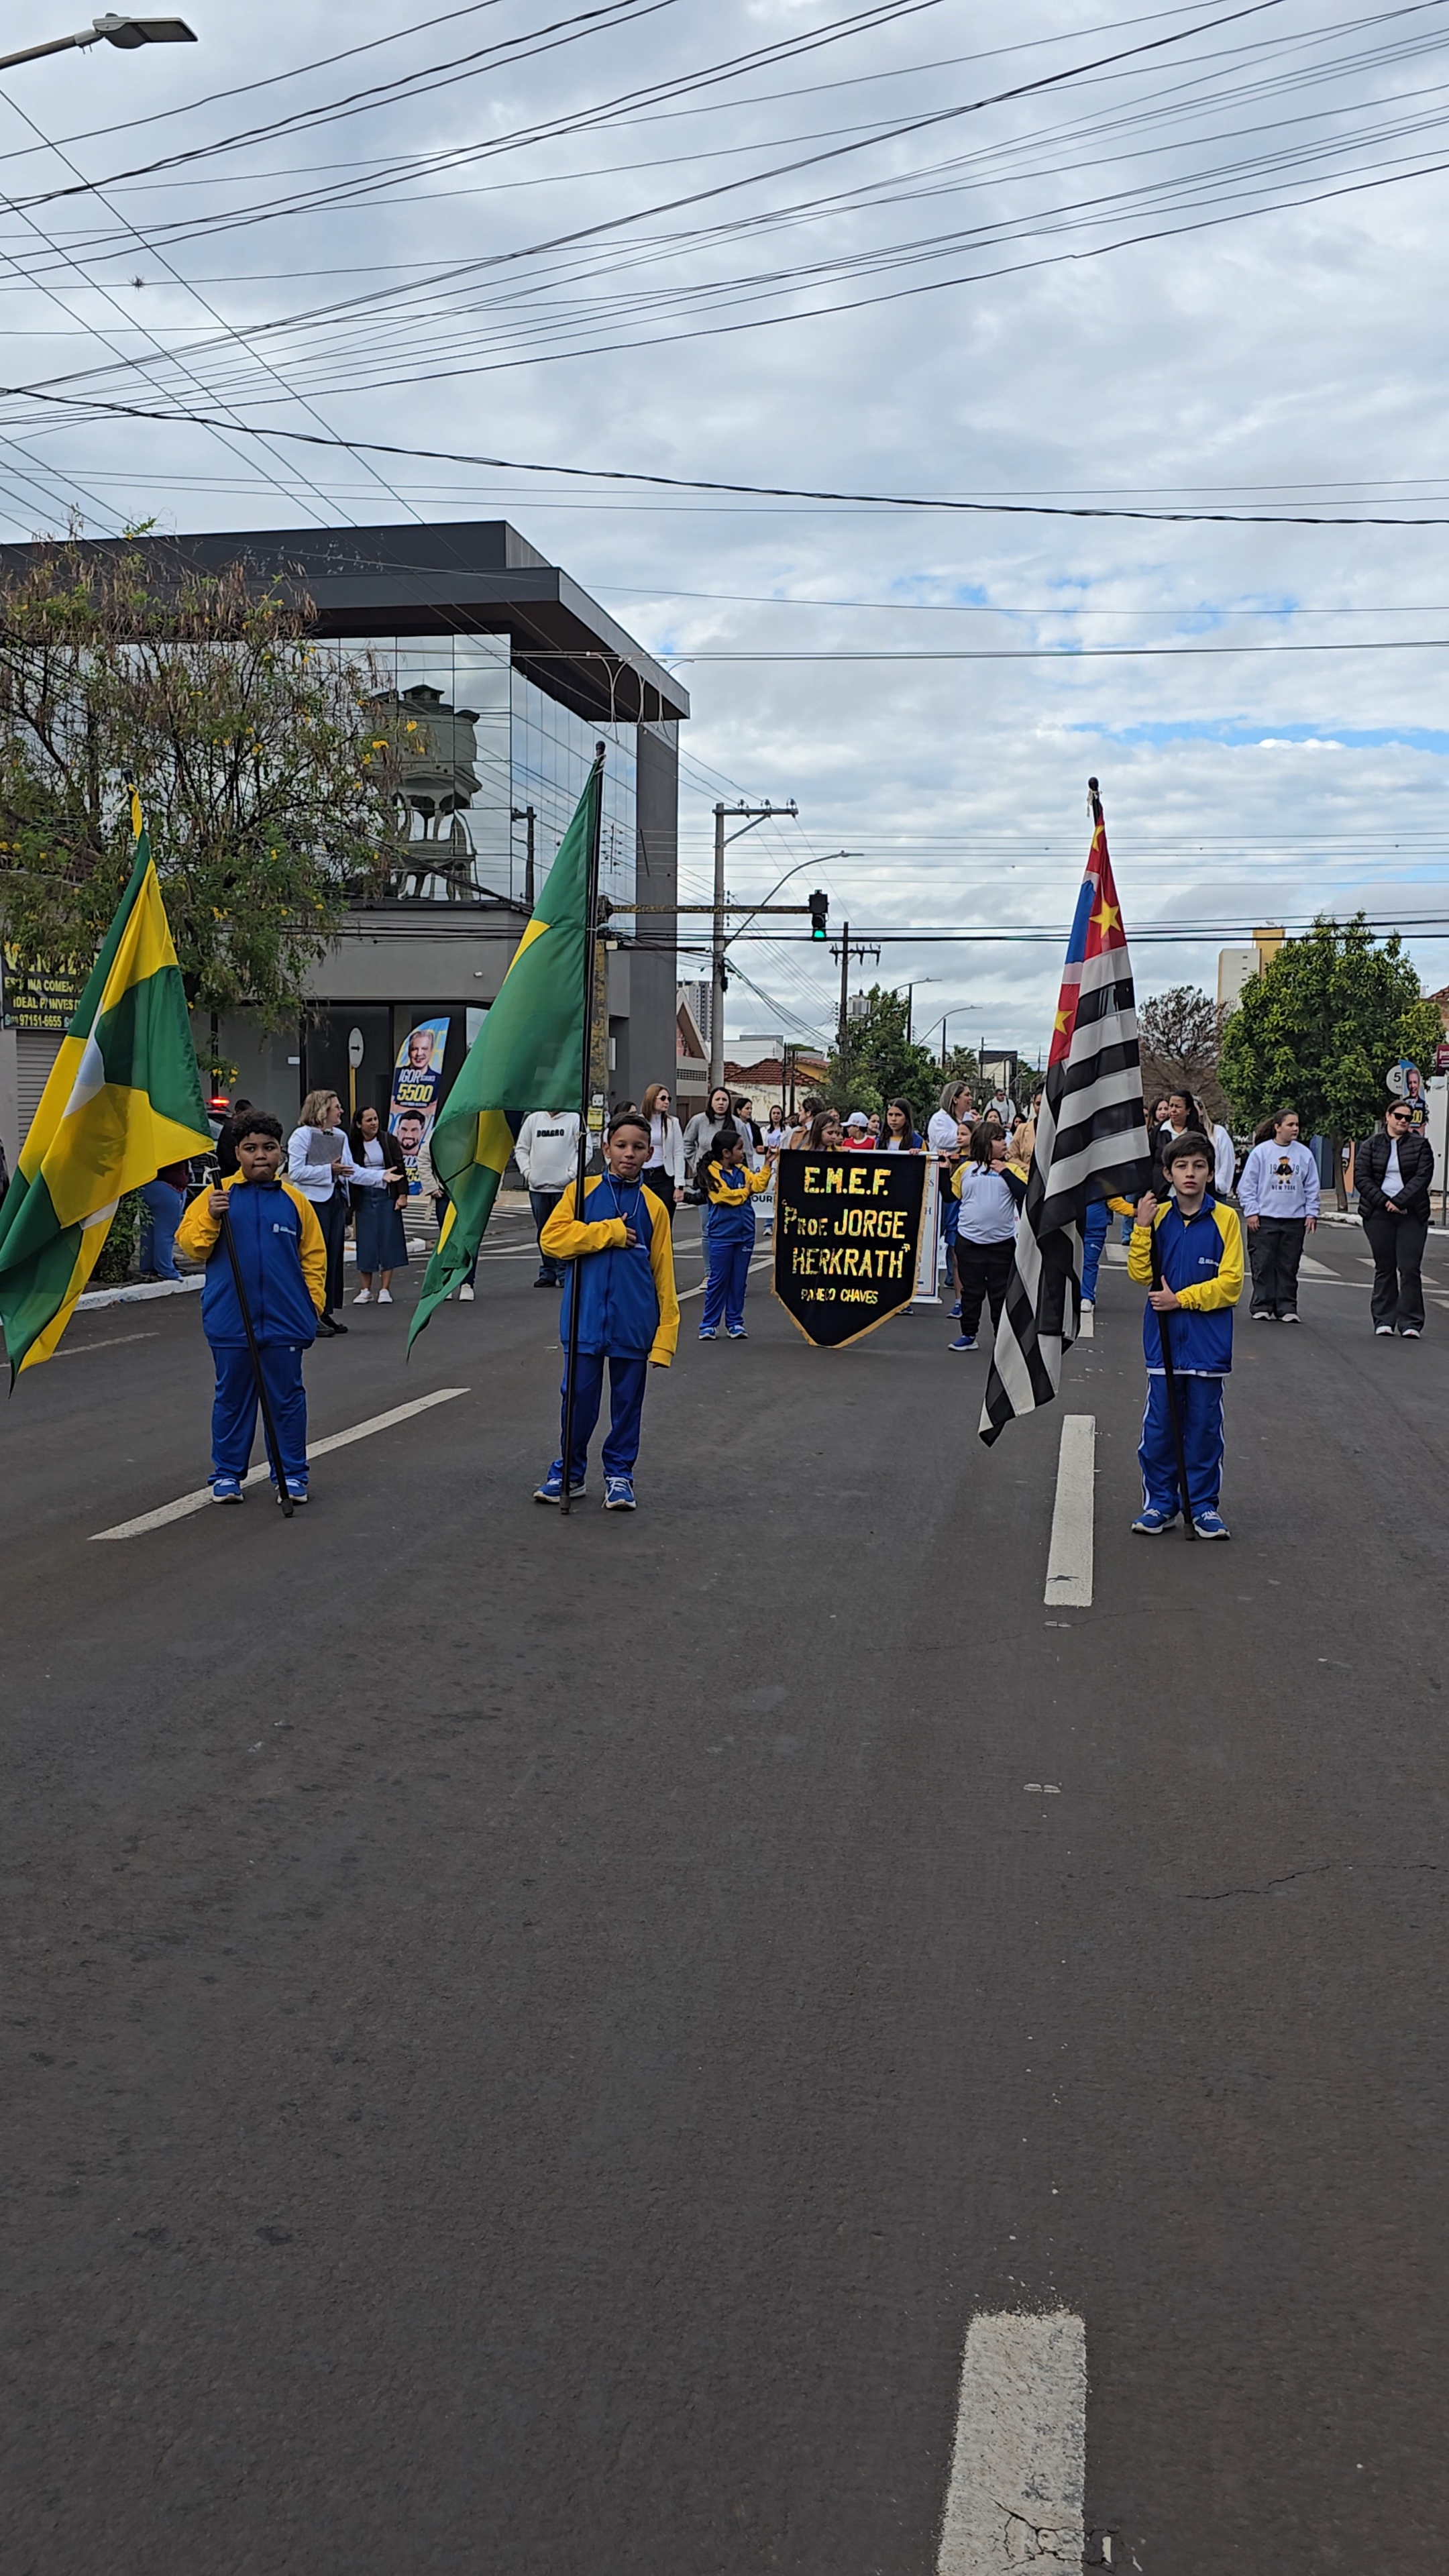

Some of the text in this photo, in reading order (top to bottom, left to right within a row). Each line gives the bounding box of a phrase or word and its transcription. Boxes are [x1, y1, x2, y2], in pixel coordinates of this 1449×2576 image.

[13, 996, 38, 1009] IDEAL
[19, 1013, 62, 1027] 97151-6655
[398, 1069, 421, 1083] IGOR
[396, 1083, 433, 1102] 5500
[834, 1209, 908, 1239] JORGE
[840, 1288, 879, 1304] CHAVES
